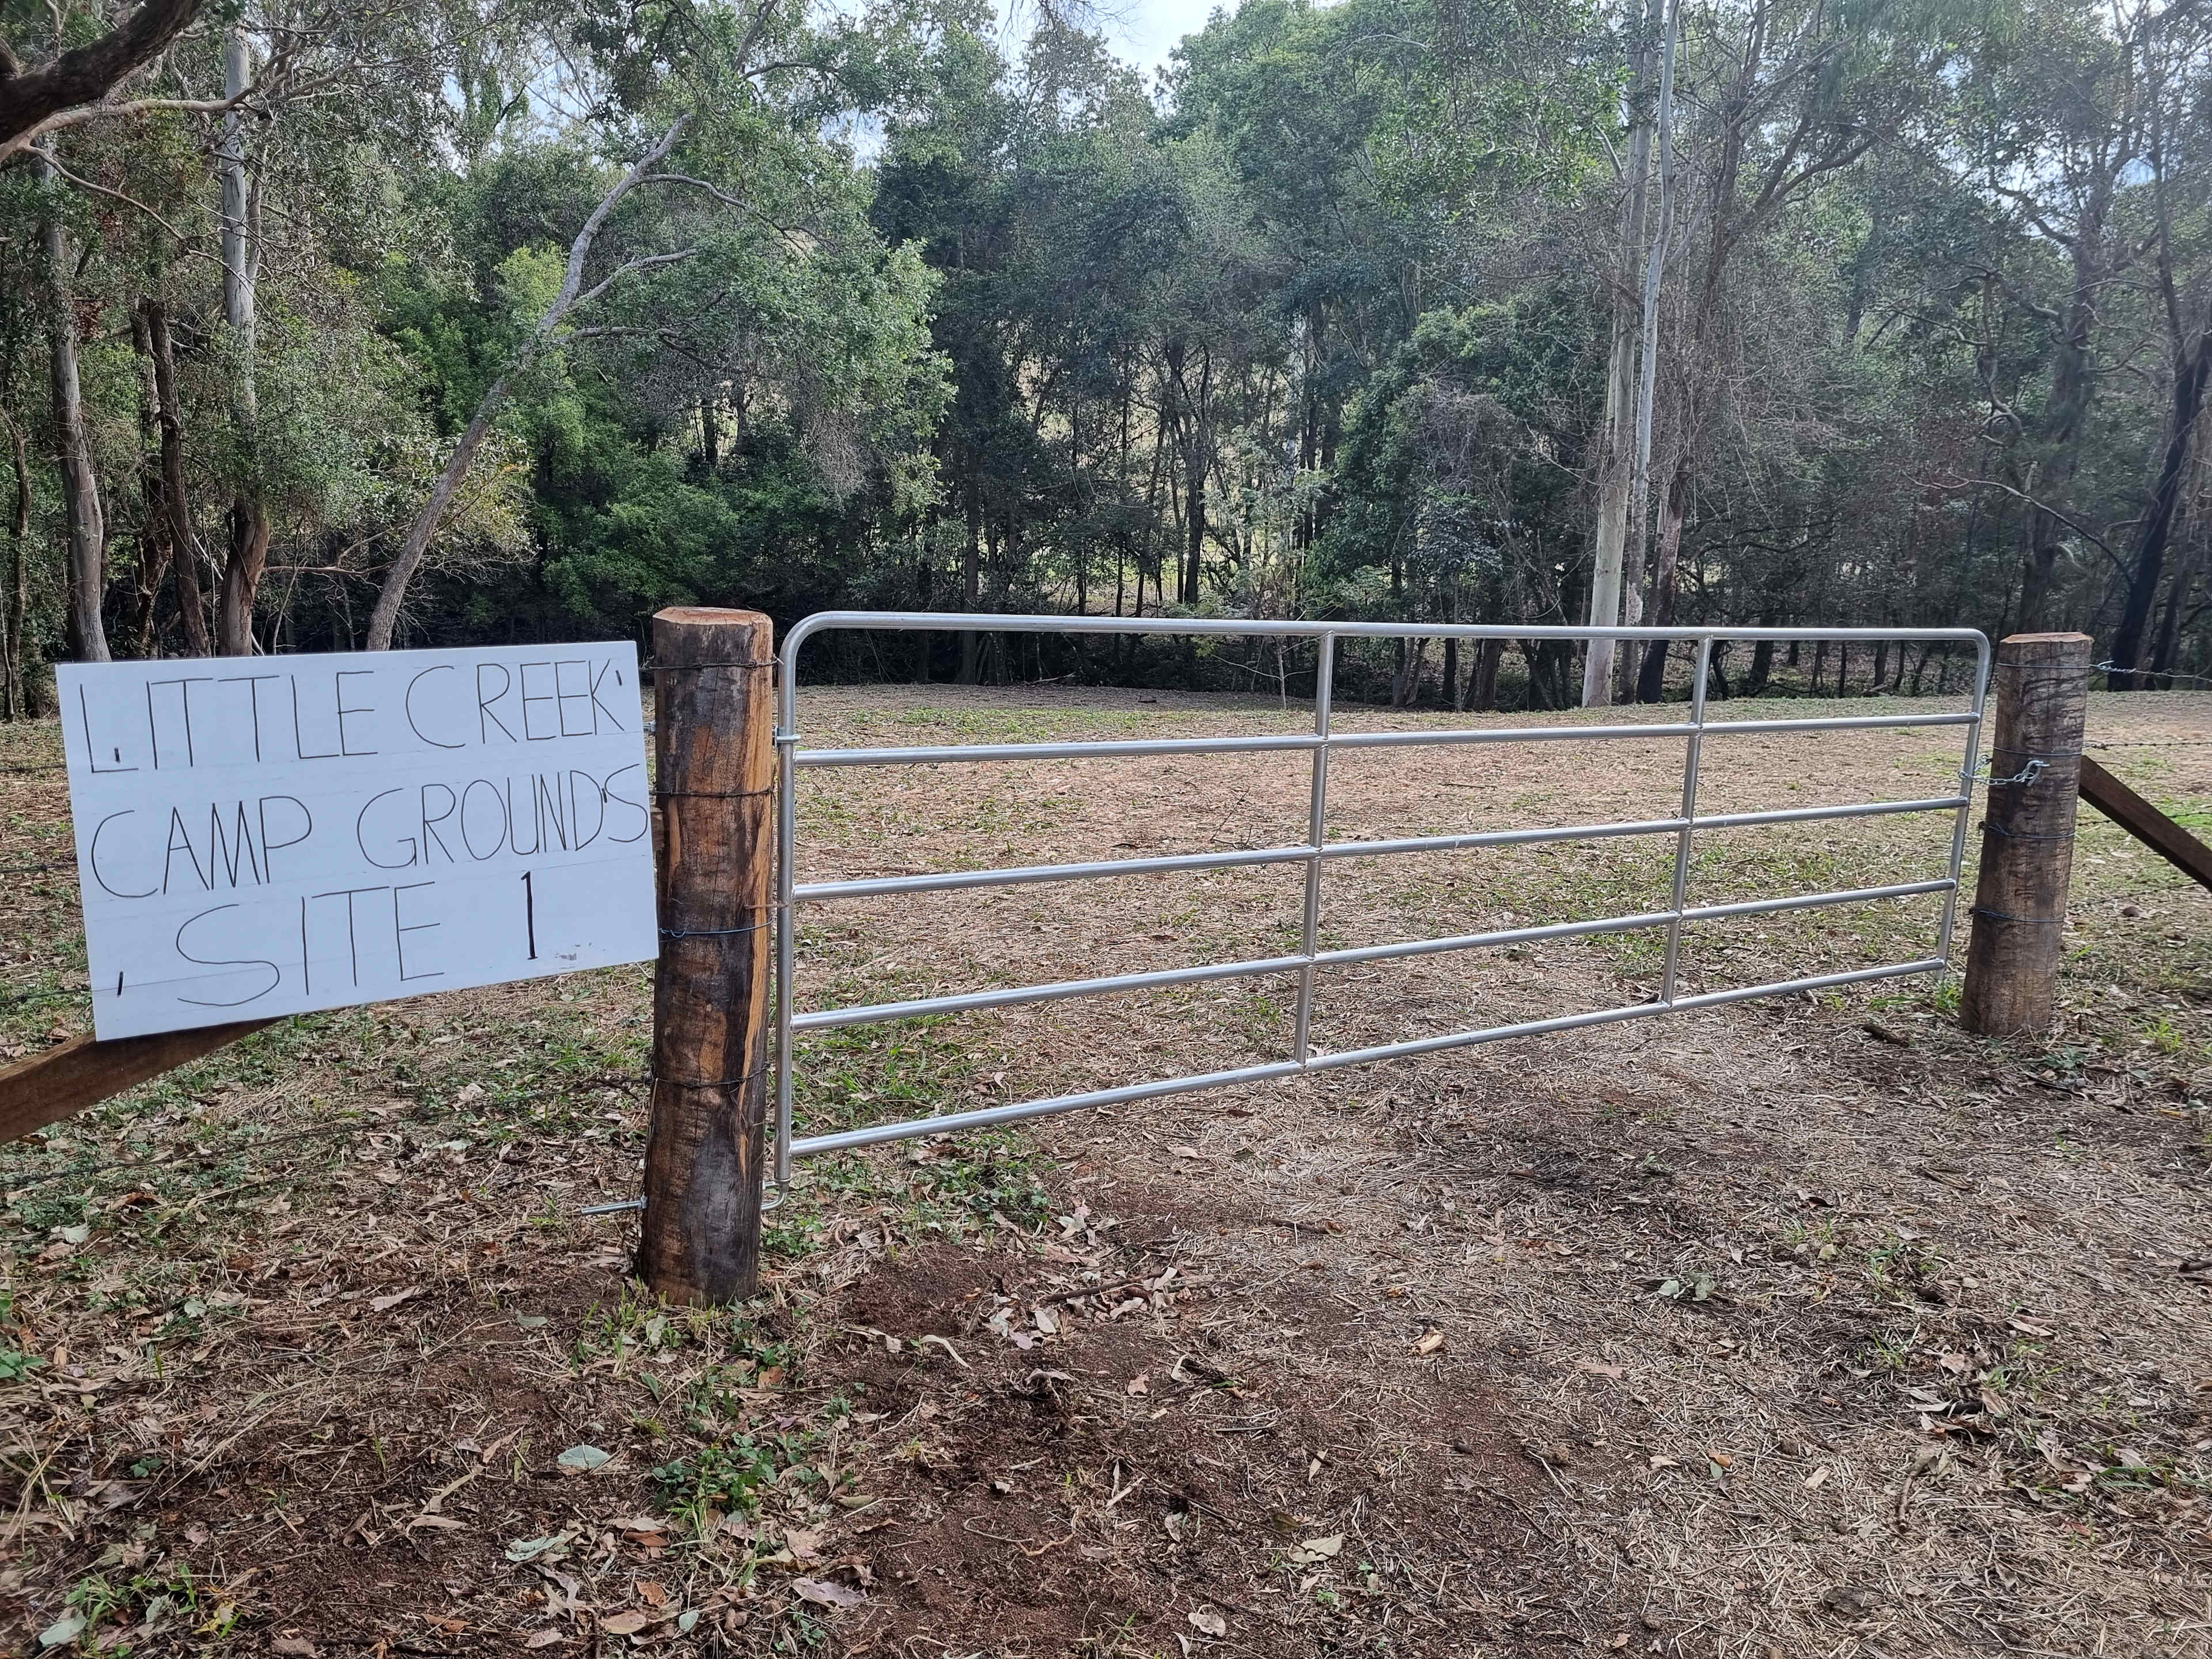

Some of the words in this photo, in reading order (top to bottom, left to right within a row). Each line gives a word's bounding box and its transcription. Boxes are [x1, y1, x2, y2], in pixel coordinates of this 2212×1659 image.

[79, 671, 378, 774] LITTLE
[406, 658, 625, 748] CREEK
[90, 796, 312, 899] CAMP
[357, 763, 649, 869] GROUNDS
[175, 881, 445, 1007] SITE
[520, 870, 539, 960] 1
